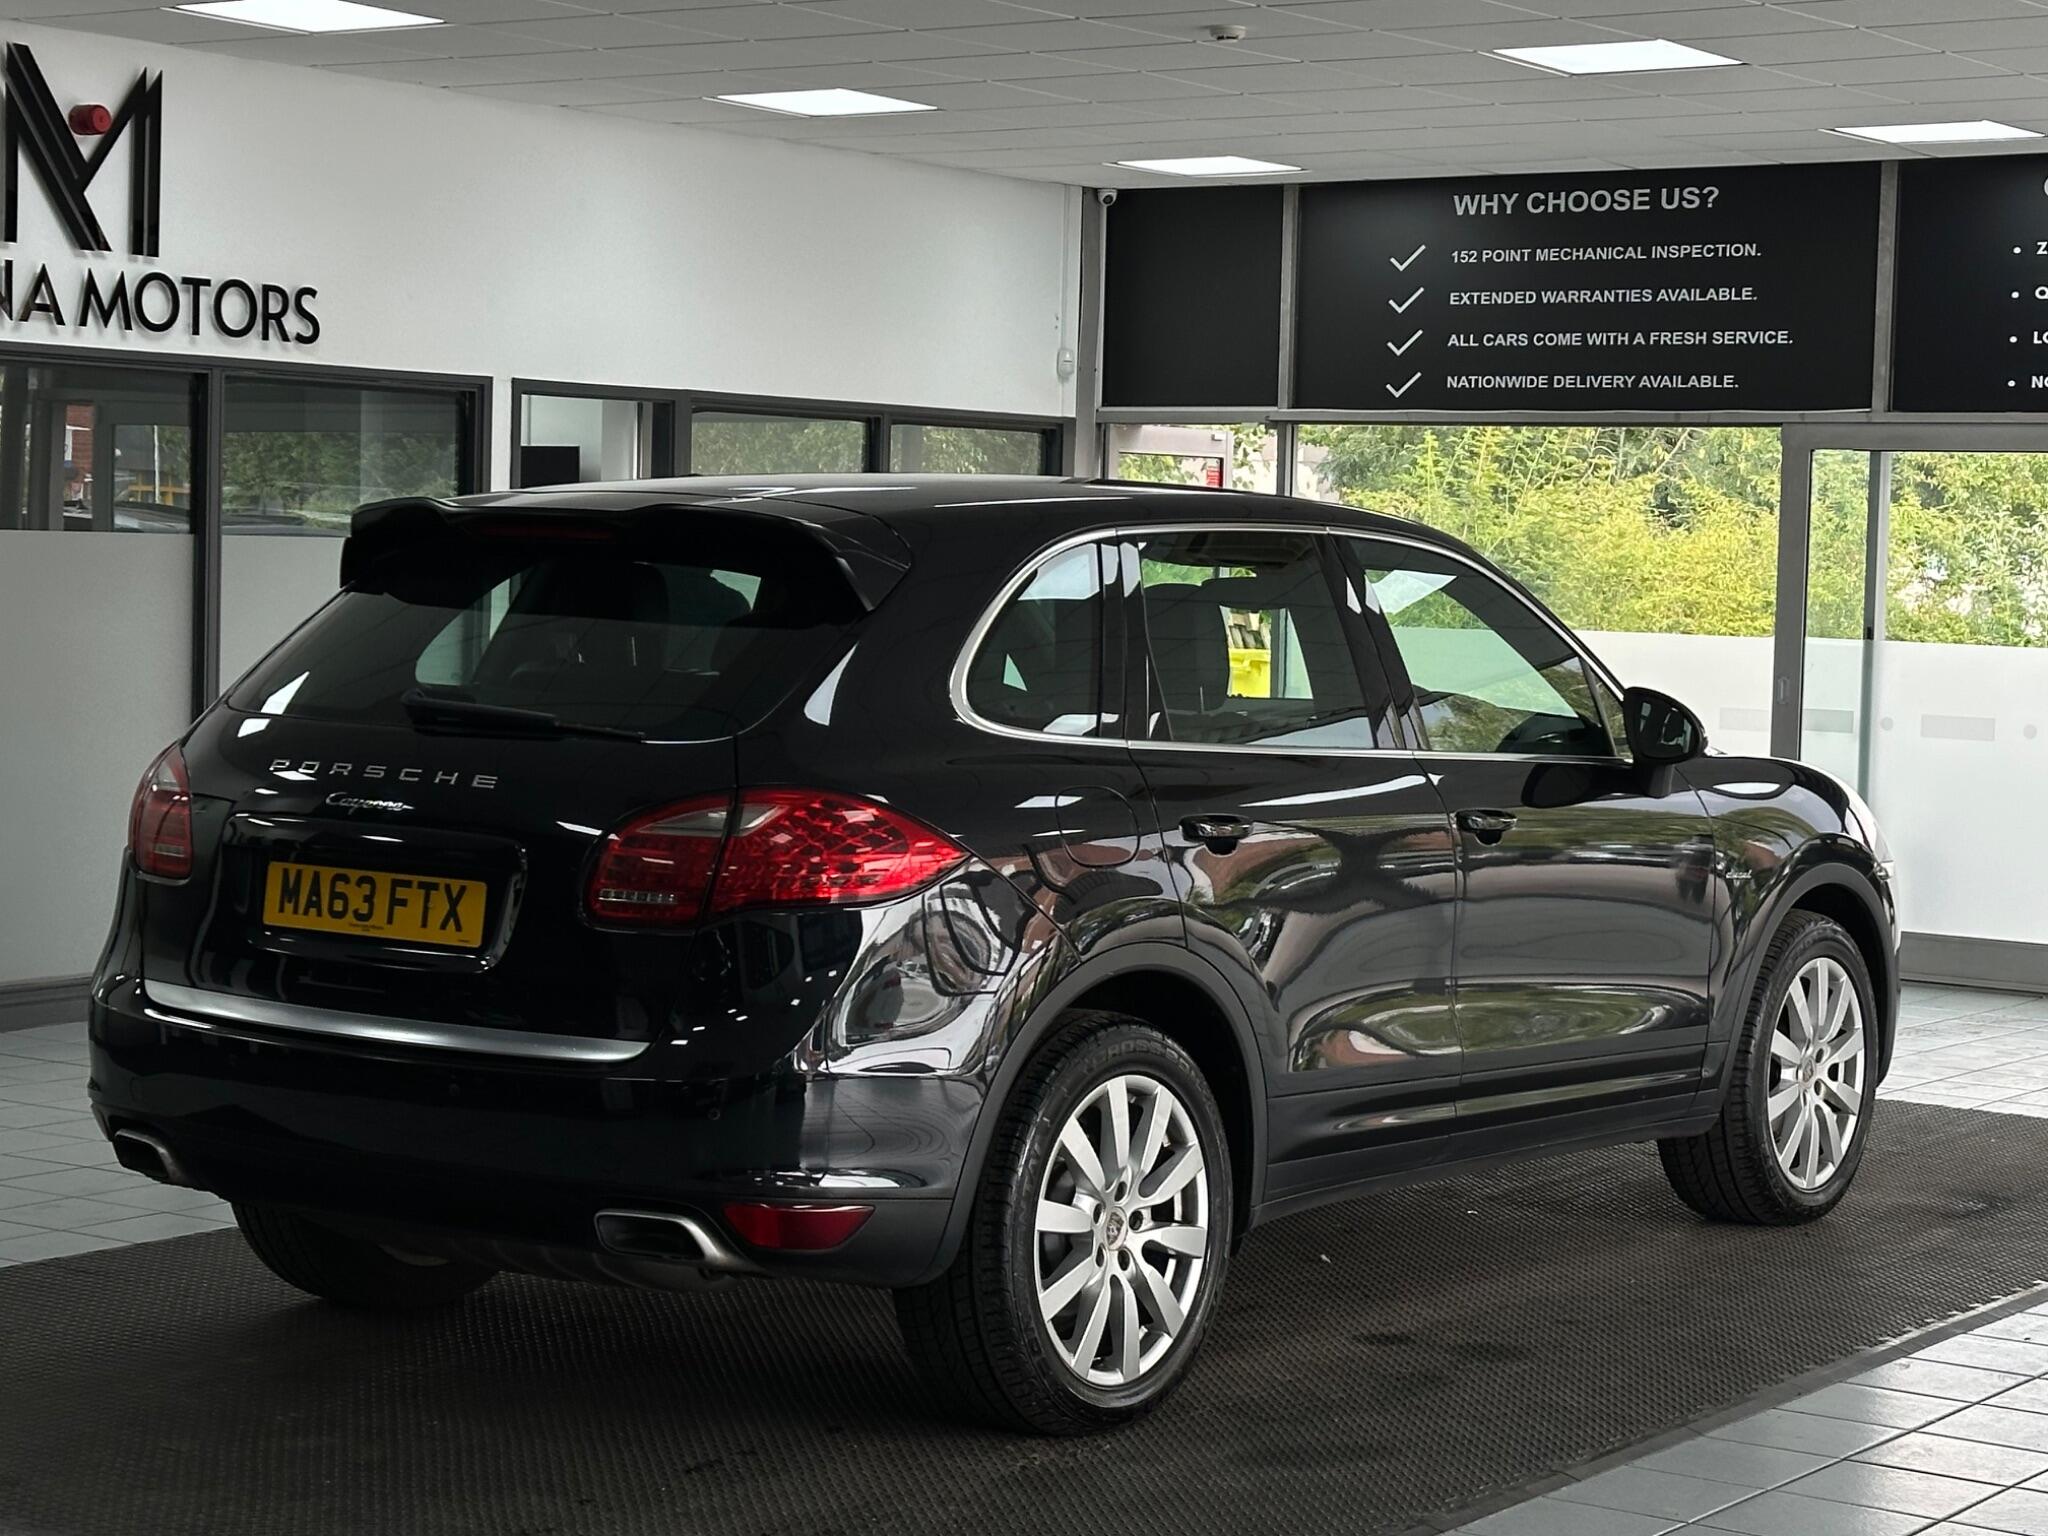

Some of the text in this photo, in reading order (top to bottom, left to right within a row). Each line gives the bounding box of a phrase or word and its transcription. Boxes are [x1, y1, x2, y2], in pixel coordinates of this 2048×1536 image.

[1452, 186, 1720, 217] WHY CHOOSE US?
[1451, 243, 1762, 264] 152 POINT MECHANICAL INSPECTION.
[78, 267, 321, 345] MOTORS
[1449, 287, 1758, 306] EXTENDED WARRANTIES AVAILABLE.
[1447, 330, 1794, 347] ALL CARS COME WITH A FRESH SERVICE.
[1446, 374, 1739, 389] NATIONWIDE DELIVERY AVAILABLE.
[269, 759, 498, 789] PORSCHE
[325, 791, 415, 815] Cayenne
[278, 867, 467, 932] MA63 FTX
